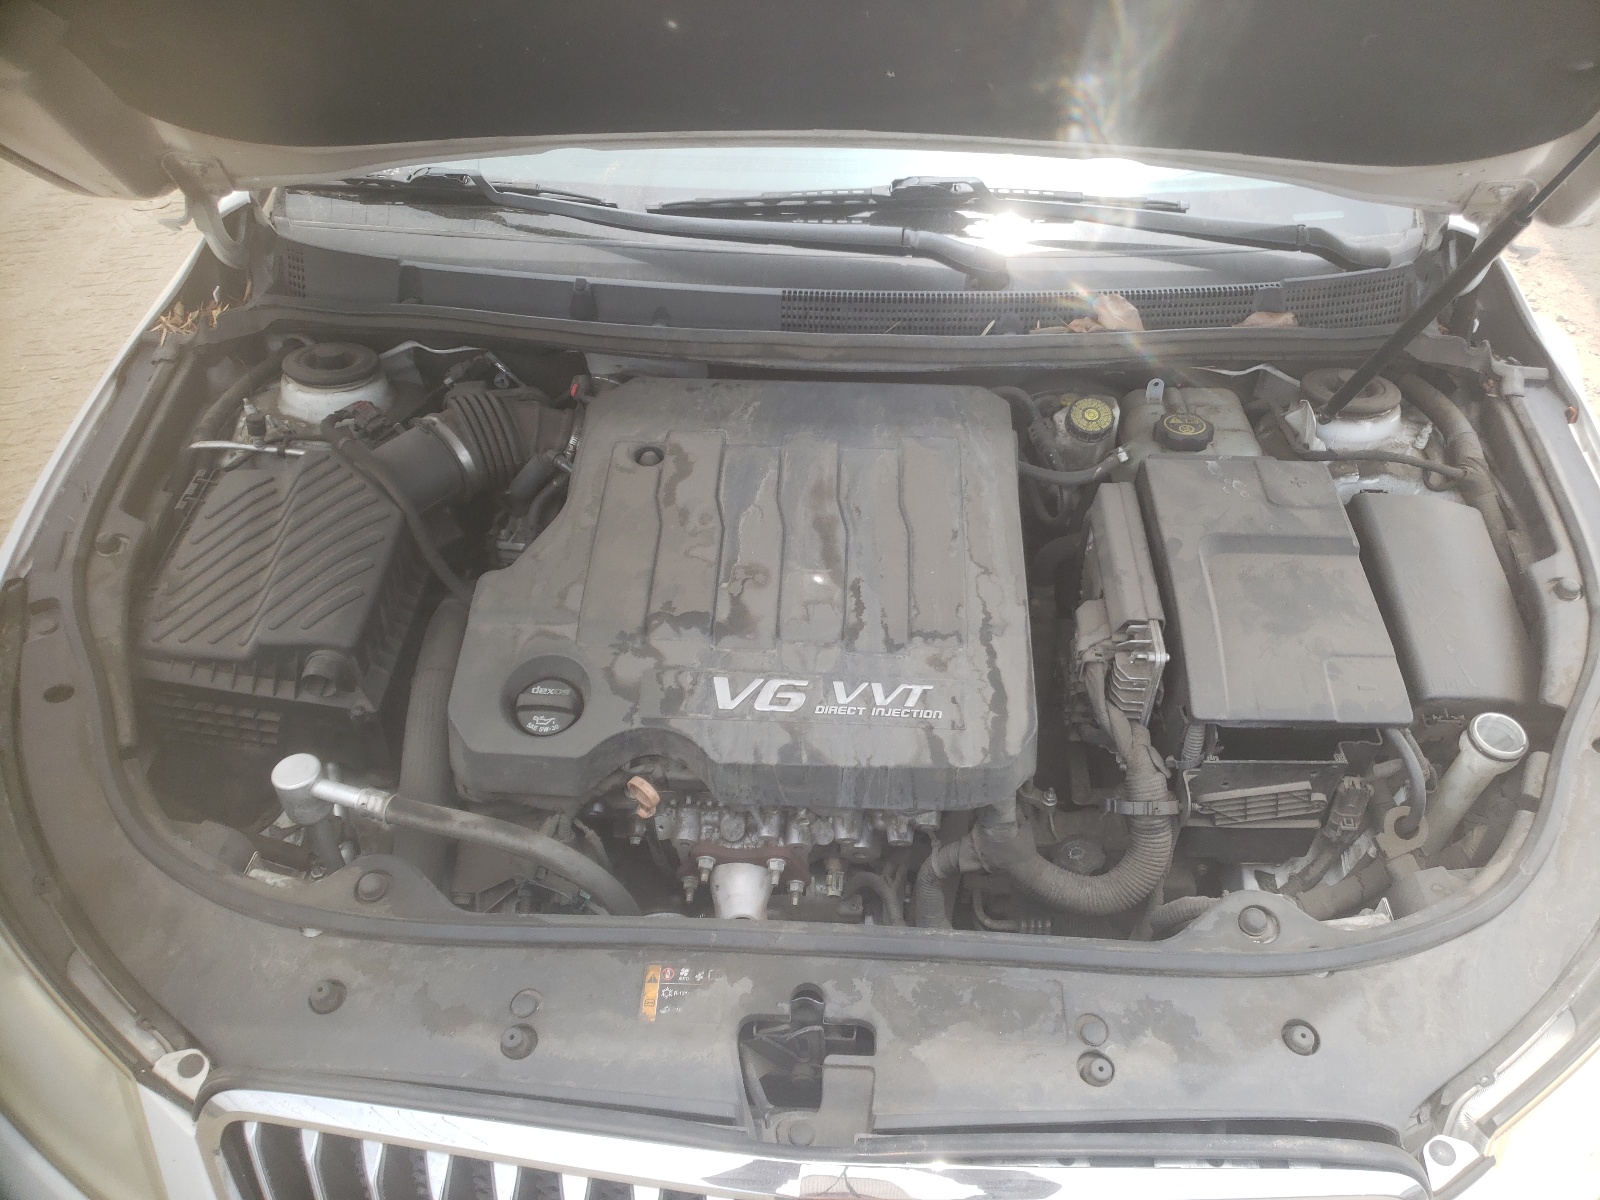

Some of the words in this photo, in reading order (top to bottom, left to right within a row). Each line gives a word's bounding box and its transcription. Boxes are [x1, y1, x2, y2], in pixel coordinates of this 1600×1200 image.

[713, 676, 809, 712] V6
[832, 680, 934, 708] VVT
[814, 705, 866, 716] DIRECT
[871, 707, 943, 719] INJECTION
